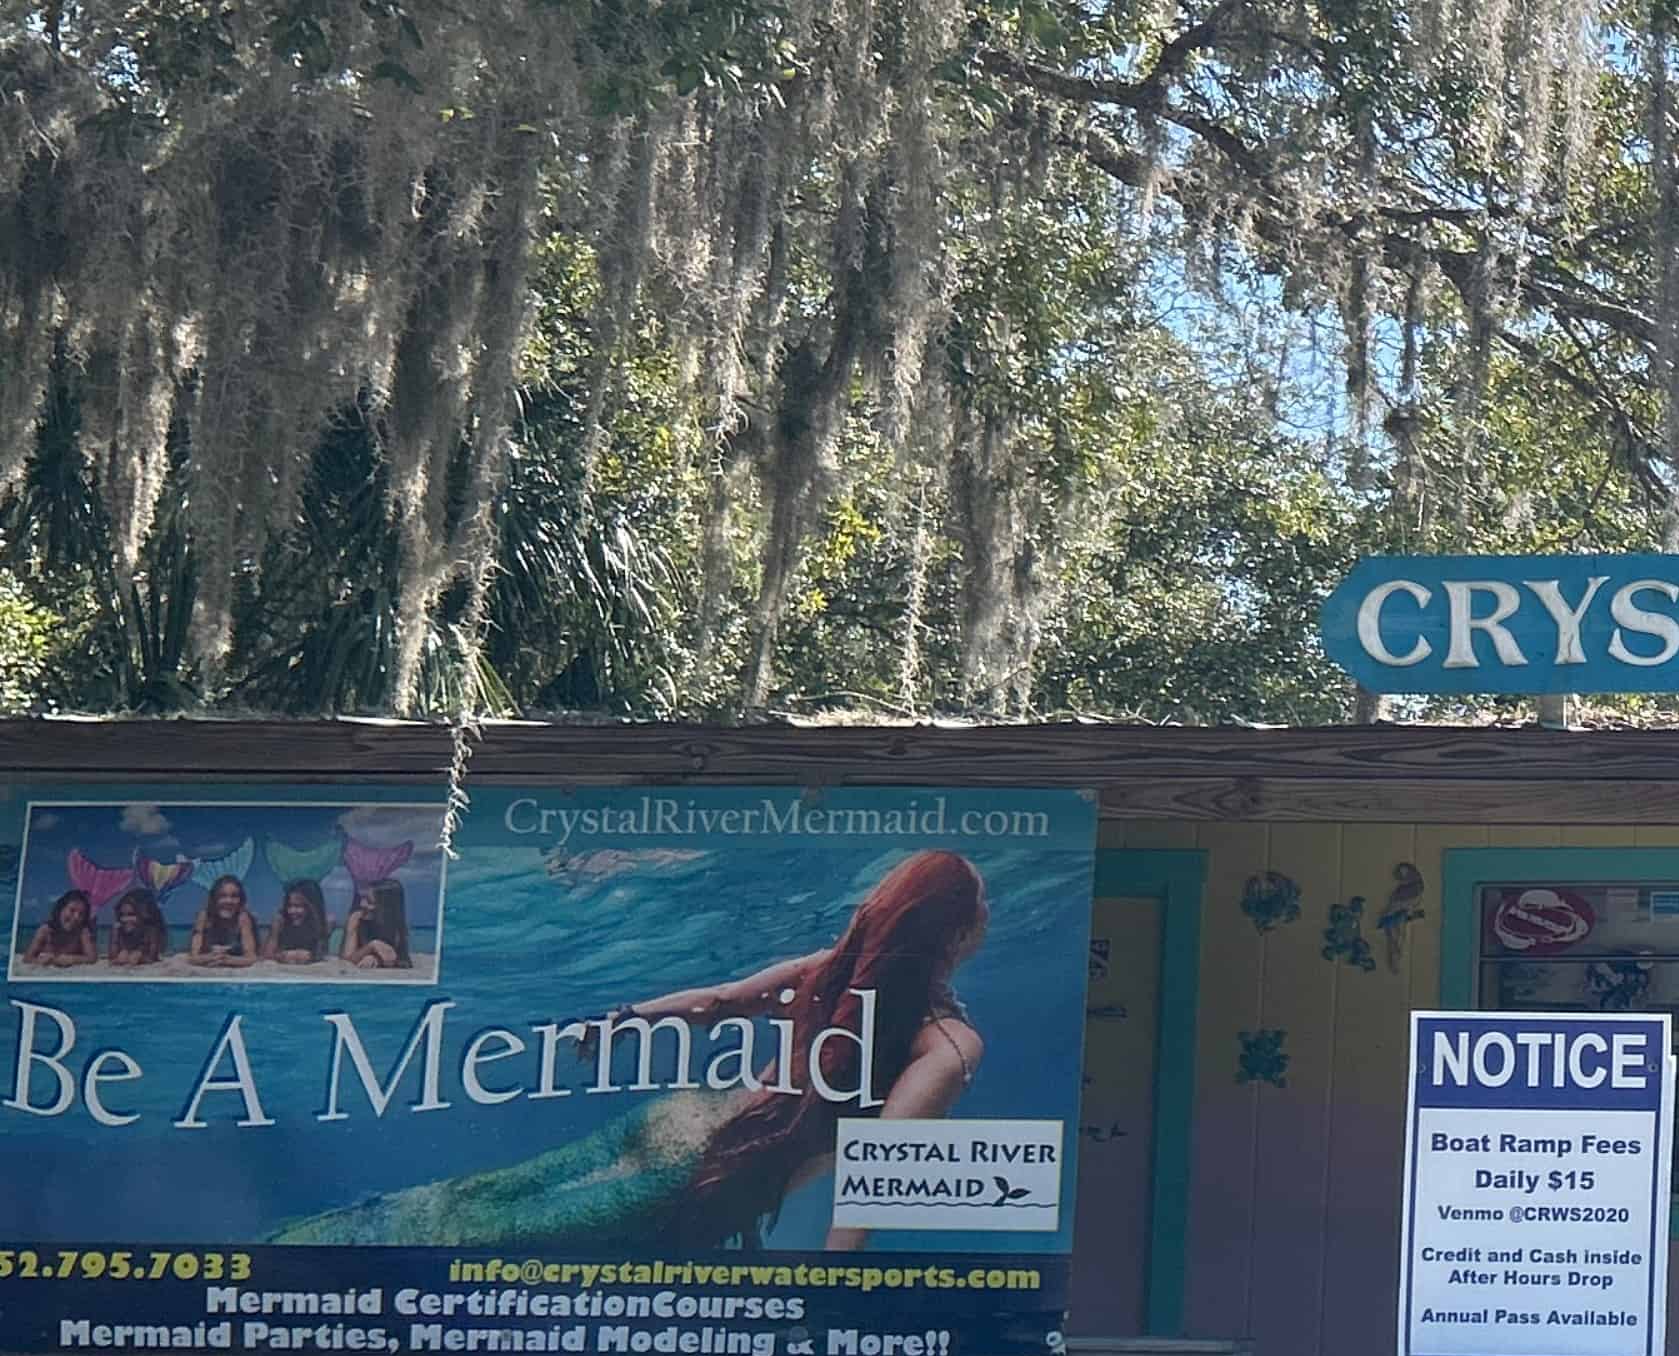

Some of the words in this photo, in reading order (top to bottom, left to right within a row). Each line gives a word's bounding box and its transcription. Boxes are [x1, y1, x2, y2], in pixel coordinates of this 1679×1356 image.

[504, 798, 1049, 845] CrystalRiverMermaid.com
[3, 999, 144, 1127] Be
[174, 1014, 276, 1129] A
[317, 988, 886, 1121] Mermaid
[1432, 1031, 1648, 1089] NOTICE
[843, 1139, 961, 1163] CRYSTAL
[970, 1140, 1057, 1164] RIVER
[1431, 1132, 1491, 1153] Boat
[1500, 1133, 1572, 1158] Ramp
[1581, 1135, 1642, 1155] Fees
[841, 1174, 985, 1198] MERMAID
[1475, 1169, 1540, 1194] Daily
[1547, 1170, 1595, 1192] $15
[1437, 1205, 1504, 1222] Venmo
[1509, 1206, 1630, 1224] @CRWS2020
[1421, 1247, 1482, 1263] Credit
[1487, 1248, 1523, 1264] and
[1529, 1249, 1578, 1265] Cash
[1583, 1249, 1643, 1266] inside
[449, 1258, 1041, 1291] info@crystalriverwatersports.com
[1448, 1269, 1498, 1285] After
[1503, 1270, 1561, 1287] Hours
[1567, 1271, 1614, 1290] Drop
[206, 1286, 382, 1316] Mermaid
[394, 1288, 805, 1319] CertificationCourses
[1421, 1308, 1489, 1324] Annual
[1495, 1309, 1541, 1325] Pass
[1547, 1310, 1638, 1327] Available
[59, 1319, 232, 1349] Mermaid
[243, 1322, 400, 1355] Parties,
[409, 1323, 585, 1353] Mermaid
[786, 1326, 815, 1356] &
[827, 1328, 950, 1356] More!!
